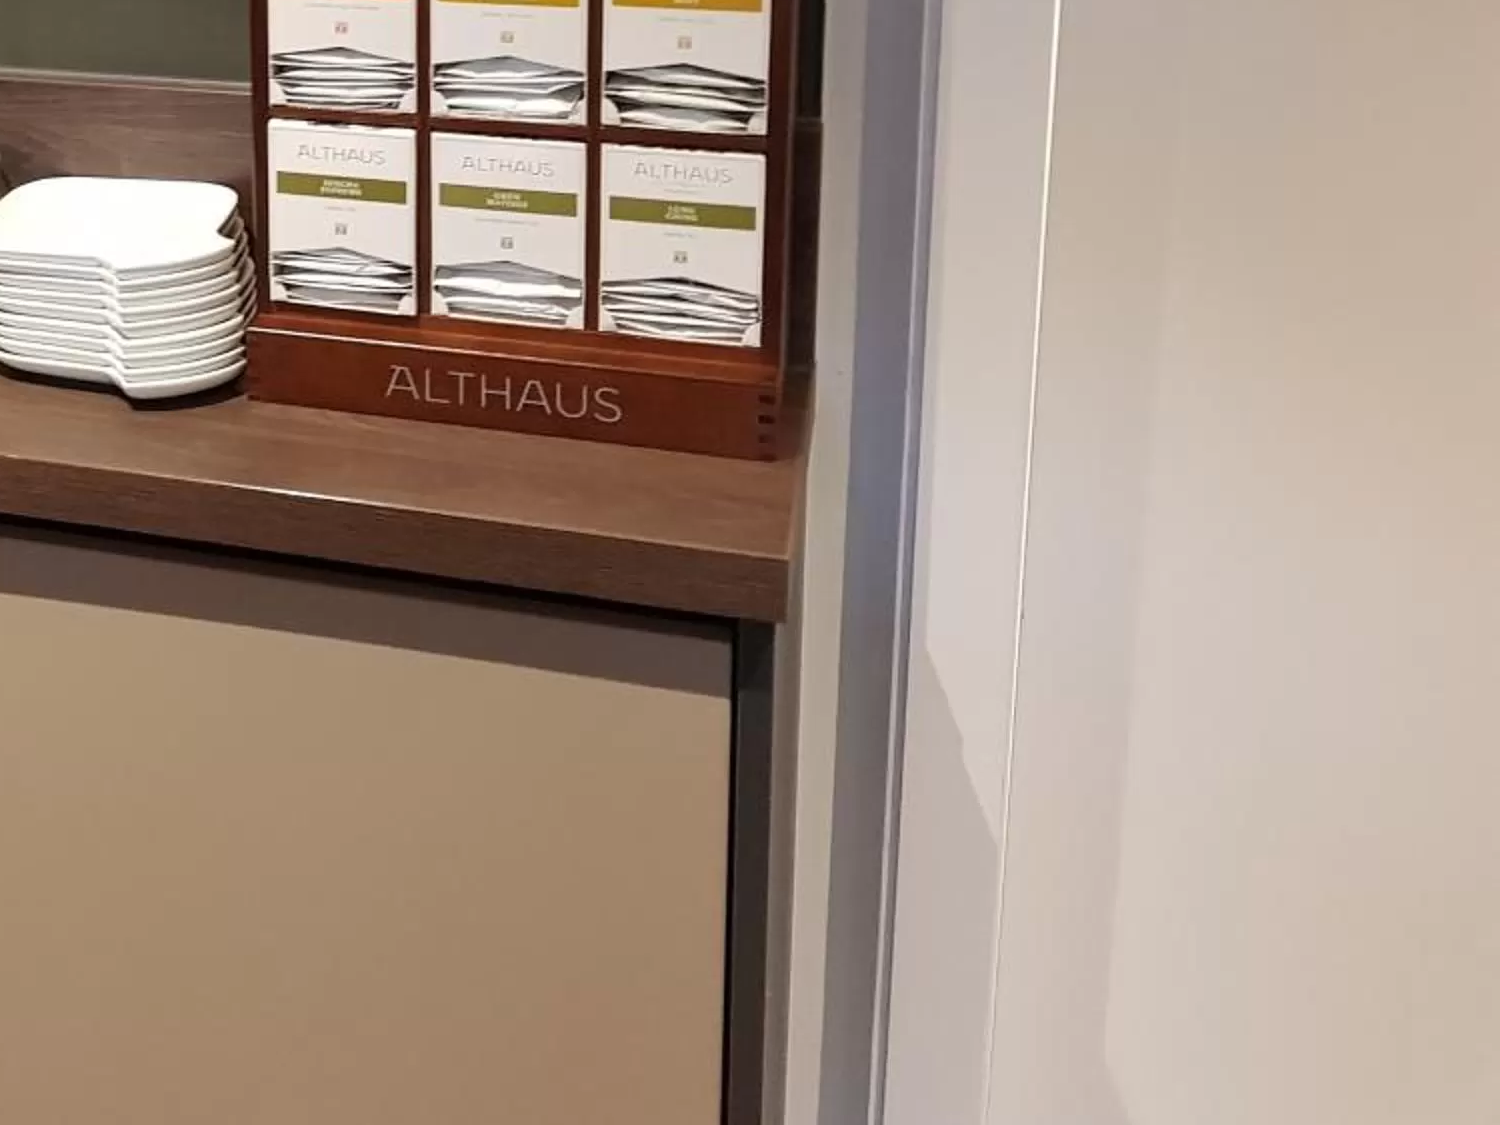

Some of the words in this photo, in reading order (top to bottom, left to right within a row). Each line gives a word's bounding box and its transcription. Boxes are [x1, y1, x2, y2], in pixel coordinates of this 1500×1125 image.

[297, 144, 386, 165] ALTHAUS
[461, 156, 555, 177] ALTHAUS
[633, 161, 734, 184] ALTHAUS
[384, 364, 623, 424] ALTHAUS
